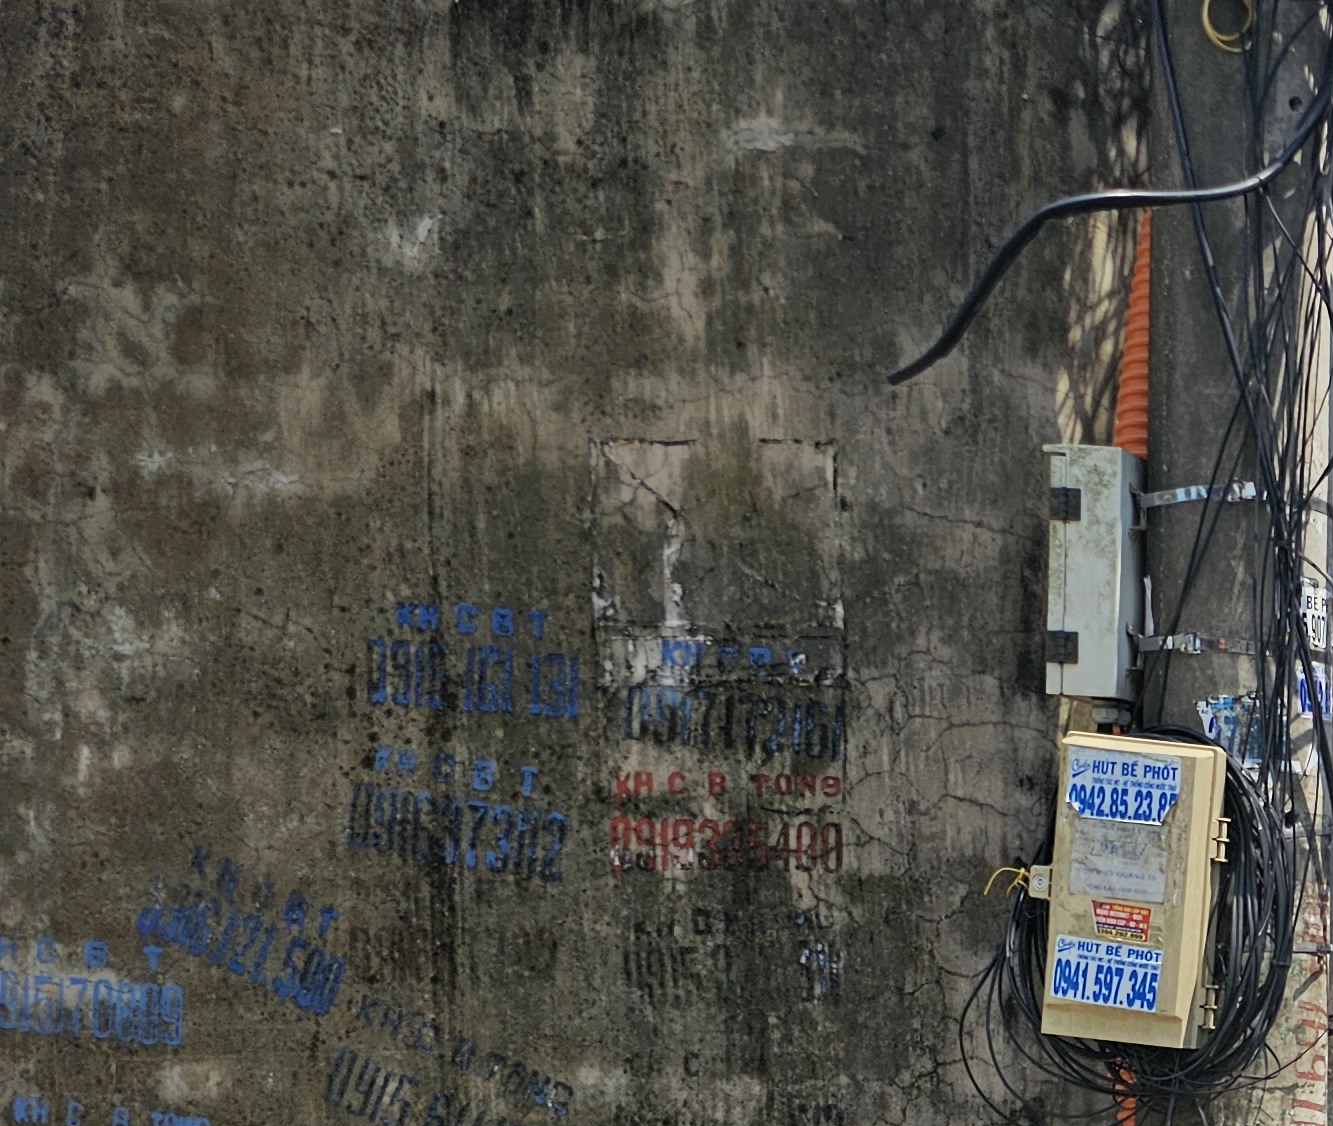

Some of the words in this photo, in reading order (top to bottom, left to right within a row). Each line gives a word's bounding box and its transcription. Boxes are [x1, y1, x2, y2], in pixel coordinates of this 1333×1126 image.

[454, 602, 477, 633] C
[491, 606, 514, 636] B
[529, 610, 547, 639] T
[472, 757, 495, 791] B
[520, 764, 538, 797] T
[615, 771, 653, 800] KH
[668, 771, 687, 795] C
[707, 772, 727, 797] B
[143, 946, 164, 972] T
[1053, 957, 1158, 1011] 0941.597.345
